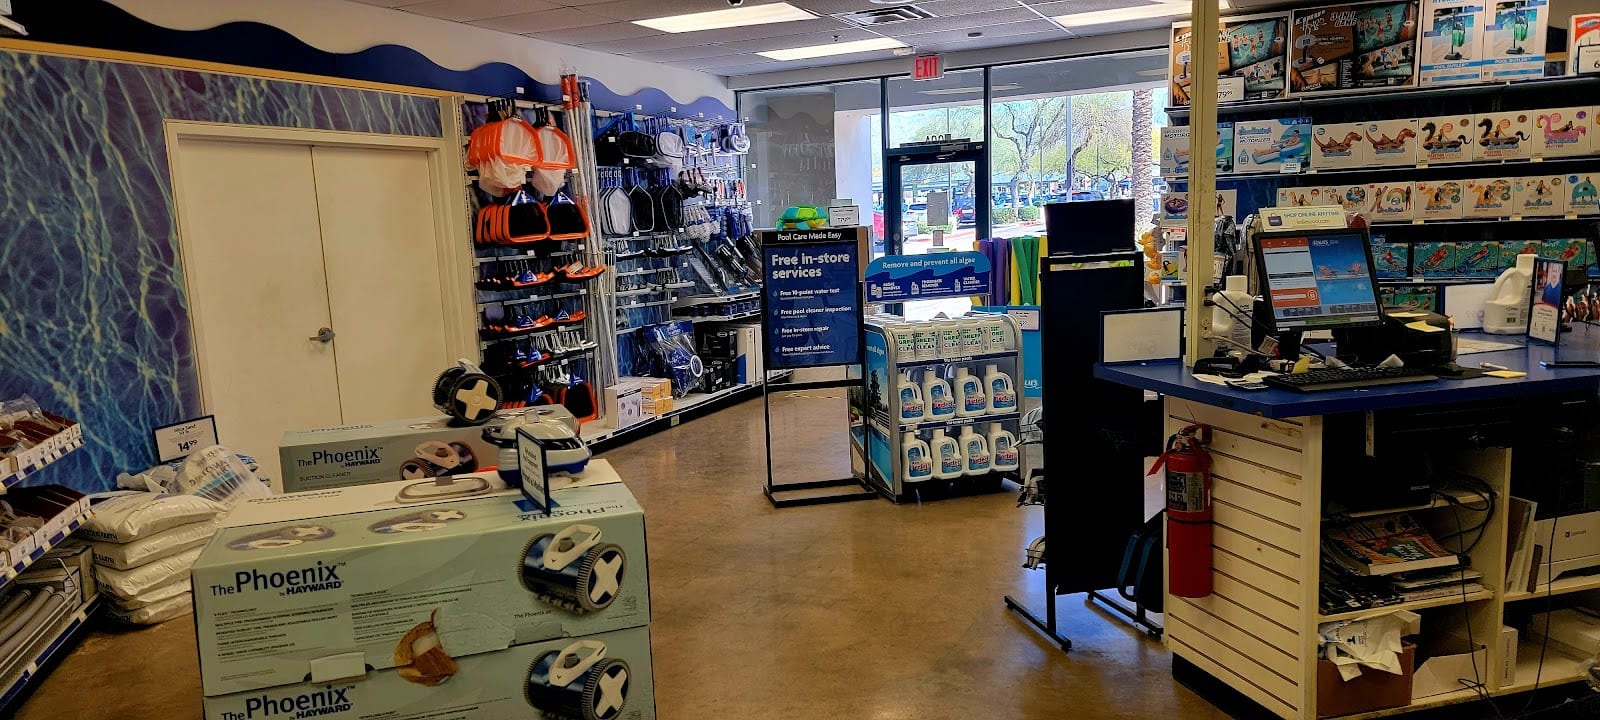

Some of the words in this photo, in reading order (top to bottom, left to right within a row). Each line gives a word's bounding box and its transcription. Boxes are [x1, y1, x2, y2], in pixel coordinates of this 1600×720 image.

[915, 56, 938, 78] EXIT
[828, 231, 842, 240] Easy
[772, 254, 798, 266] Free
[802, 252, 850, 265] in-store
[924, 259, 948, 268] prevent
[772, 267, 822, 280] services
[297, 459, 313, 467] The
[345, 459, 381, 467] HAYWARD
[210, 584, 235, 597] The
[286, 581, 342, 596] HAYWARD
[222, 711, 246, 720] The
[296, 703, 352, 719] HAYWARD
